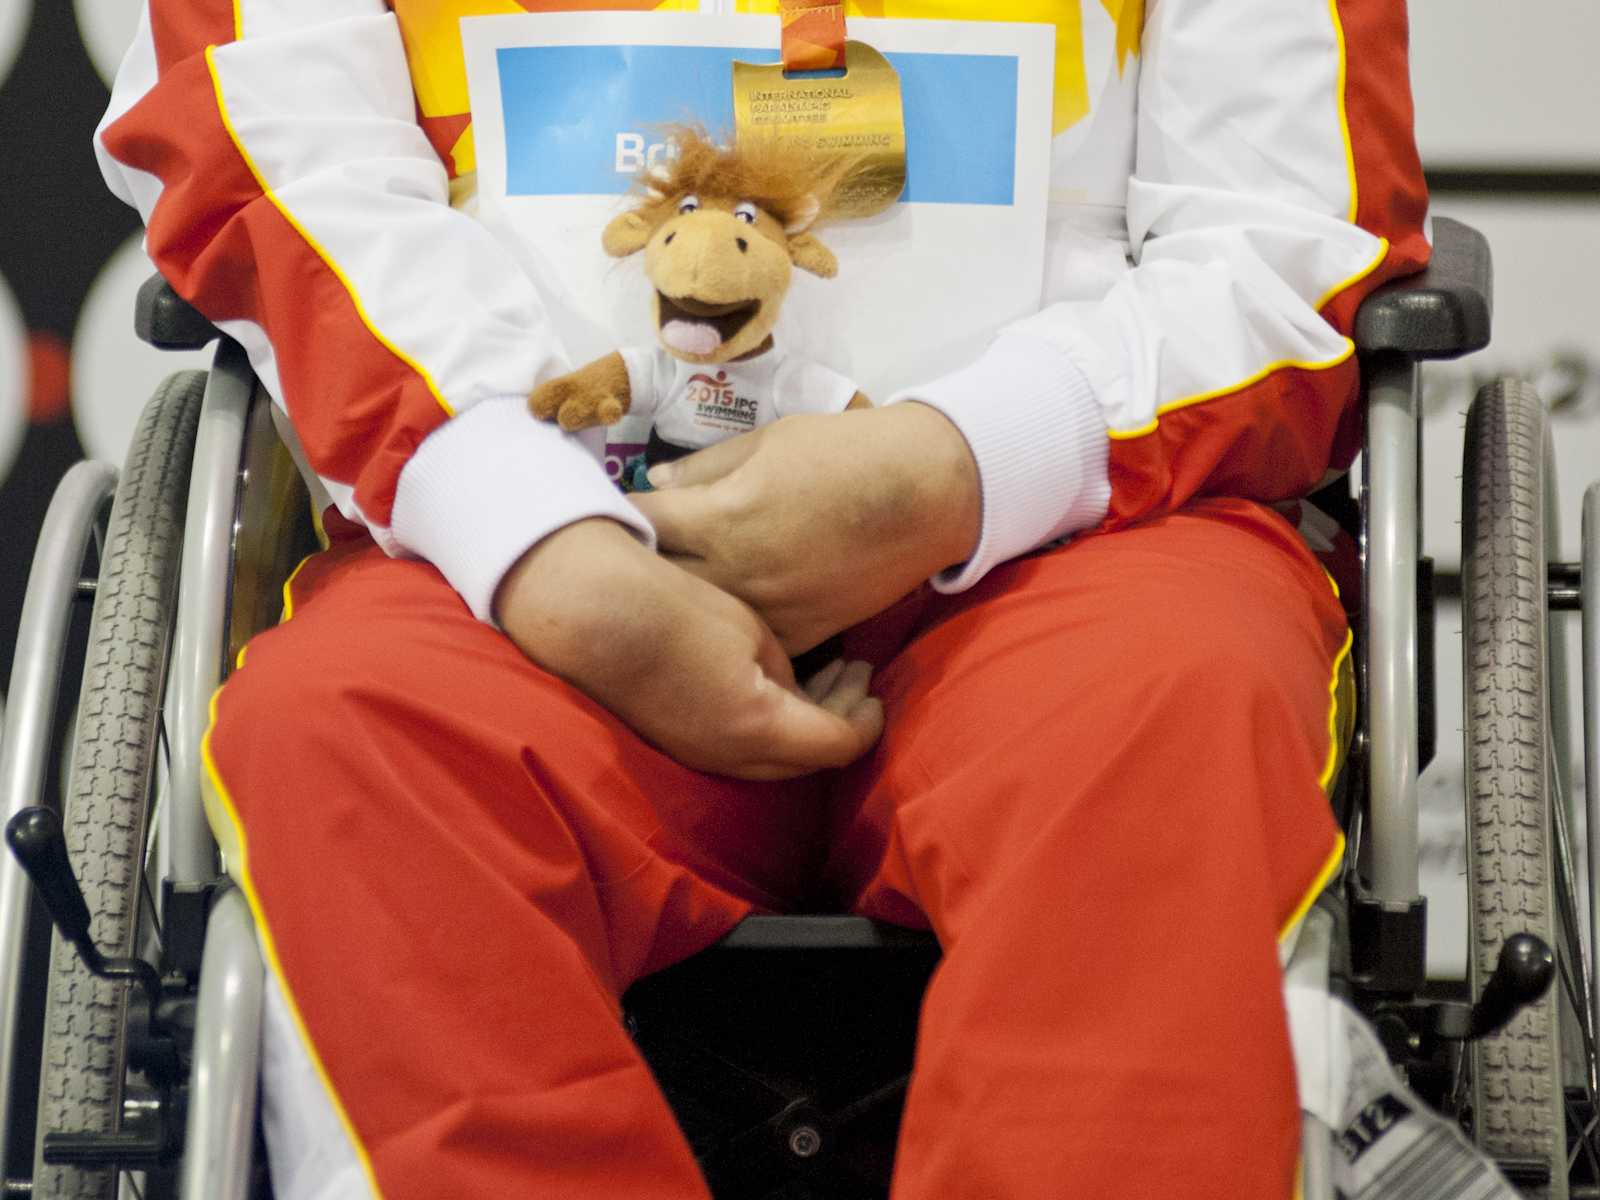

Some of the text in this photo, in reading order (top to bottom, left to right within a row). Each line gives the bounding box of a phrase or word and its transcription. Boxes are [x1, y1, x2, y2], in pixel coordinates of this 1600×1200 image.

[750, 88, 852, 101] INTERNATIONAL
[751, 101, 831, 113] PARALYMPIC
[814, 133, 891, 149] SWIMMING
[686, 386, 758, 412] 2015 IPC
[696, 403, 757, 421] SWIMMING
